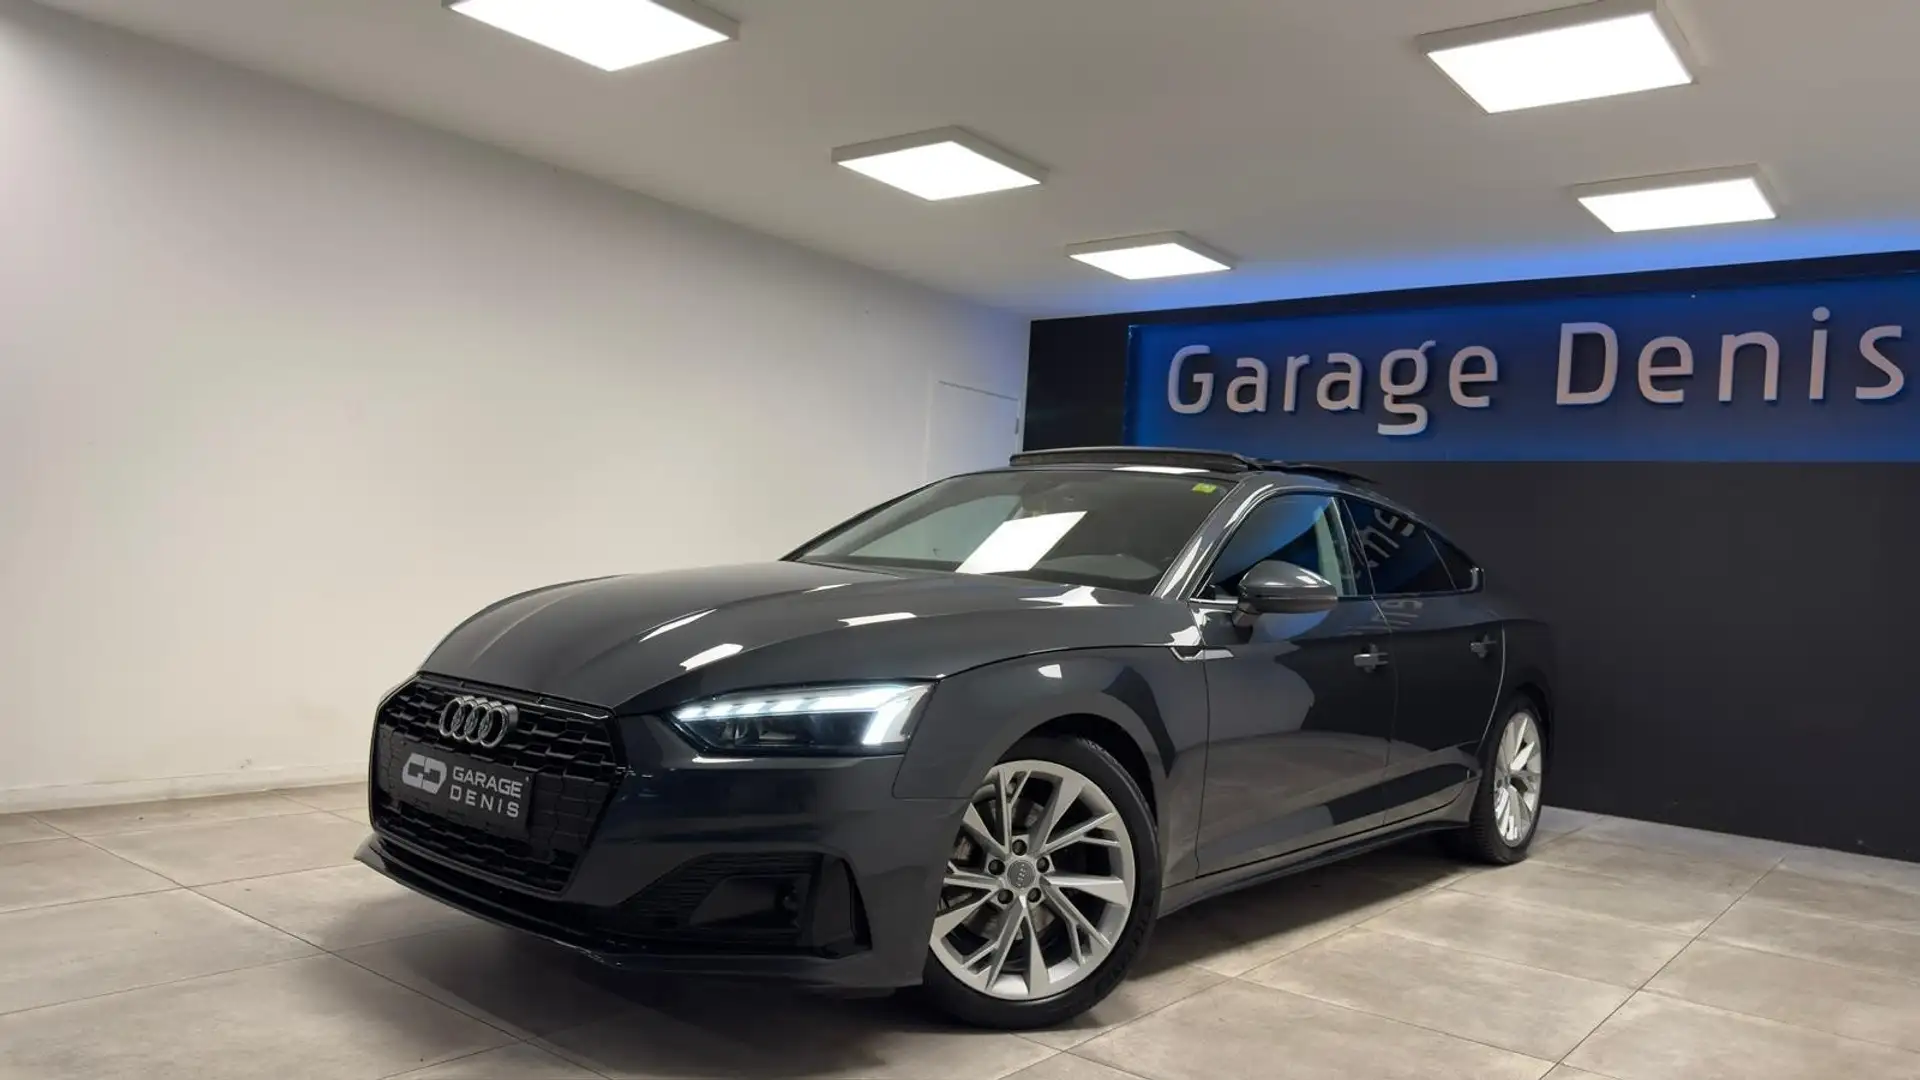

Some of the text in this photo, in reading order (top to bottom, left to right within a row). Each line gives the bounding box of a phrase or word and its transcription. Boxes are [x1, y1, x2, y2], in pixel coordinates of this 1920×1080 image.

[1167, 307, 1906, 436] Garage Denis
[452, 766, 523, 798] GARAGE
[451, 785, 520, 818] DENIS
